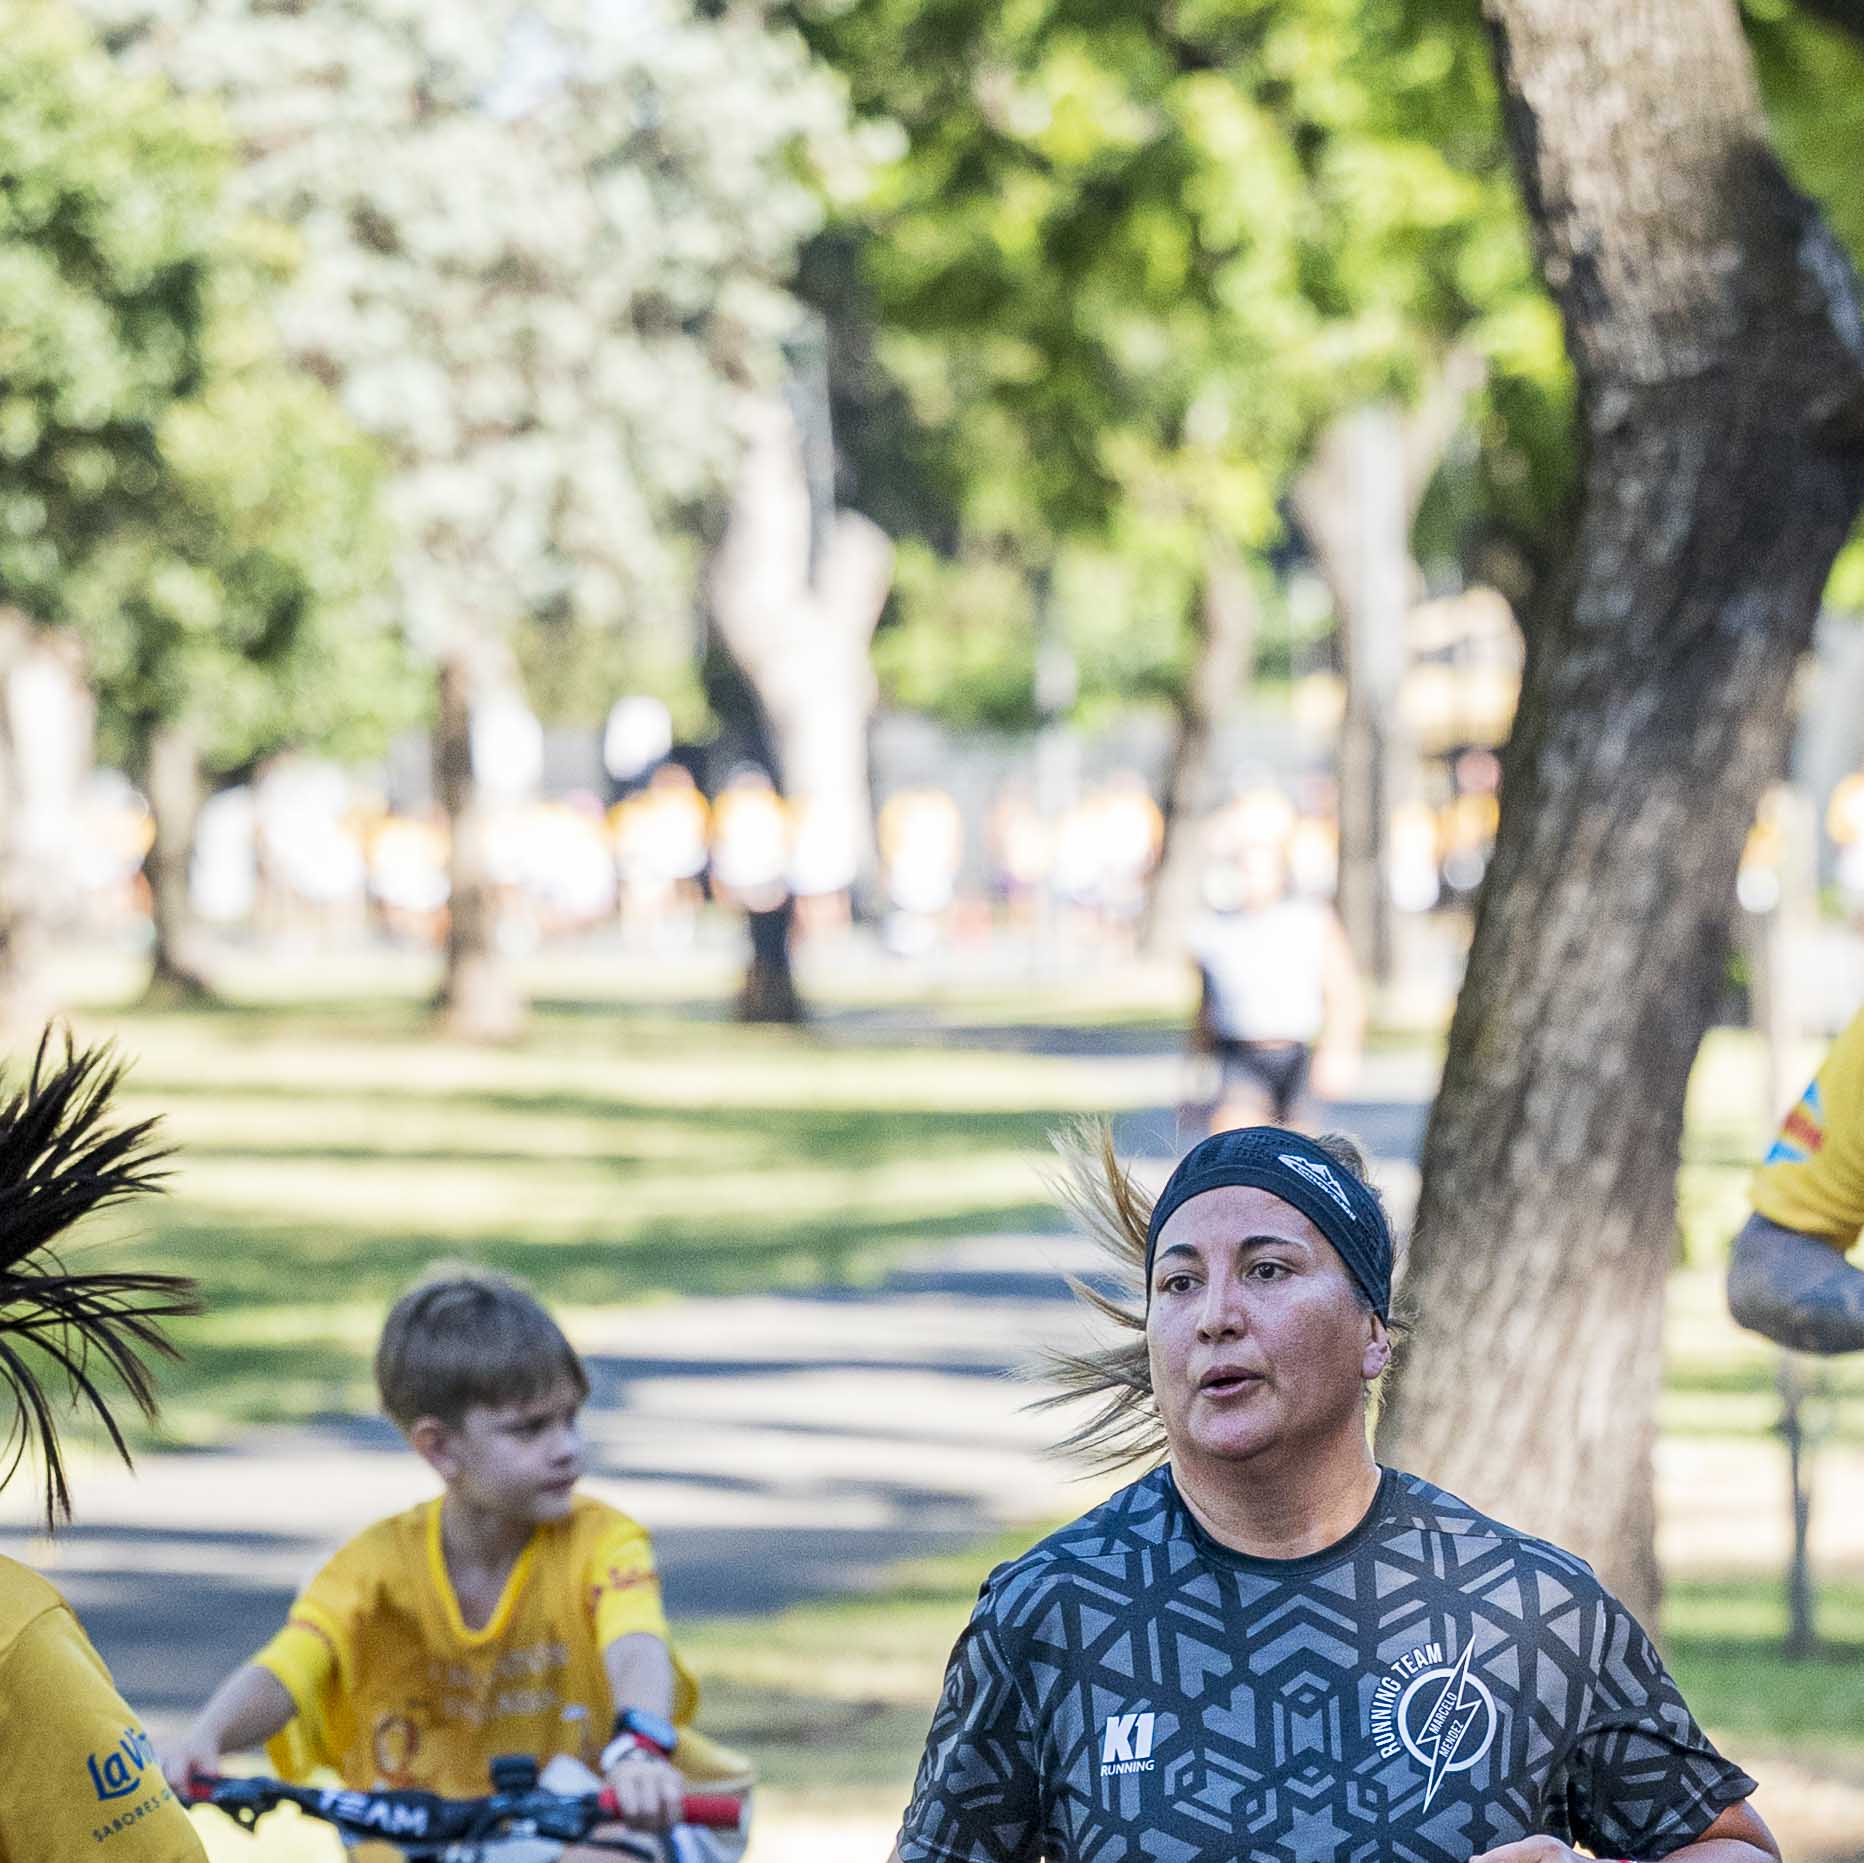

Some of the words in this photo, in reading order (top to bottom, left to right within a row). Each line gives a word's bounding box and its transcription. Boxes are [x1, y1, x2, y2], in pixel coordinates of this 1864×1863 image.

[1371, 1676, 1401, 1759] RUNNING
[1391, 1642, 1443, 1680] TEAM
[1428, 1691, 1457, 1735] MARCELO
[1102, 1712, 1155, 1763] K1
[1438, 1719, 1464, 1758] MENDEZ
[1100, 1759, 1155, 1777] RUNNING
[92, 1796, 160, 1842] SABORES
